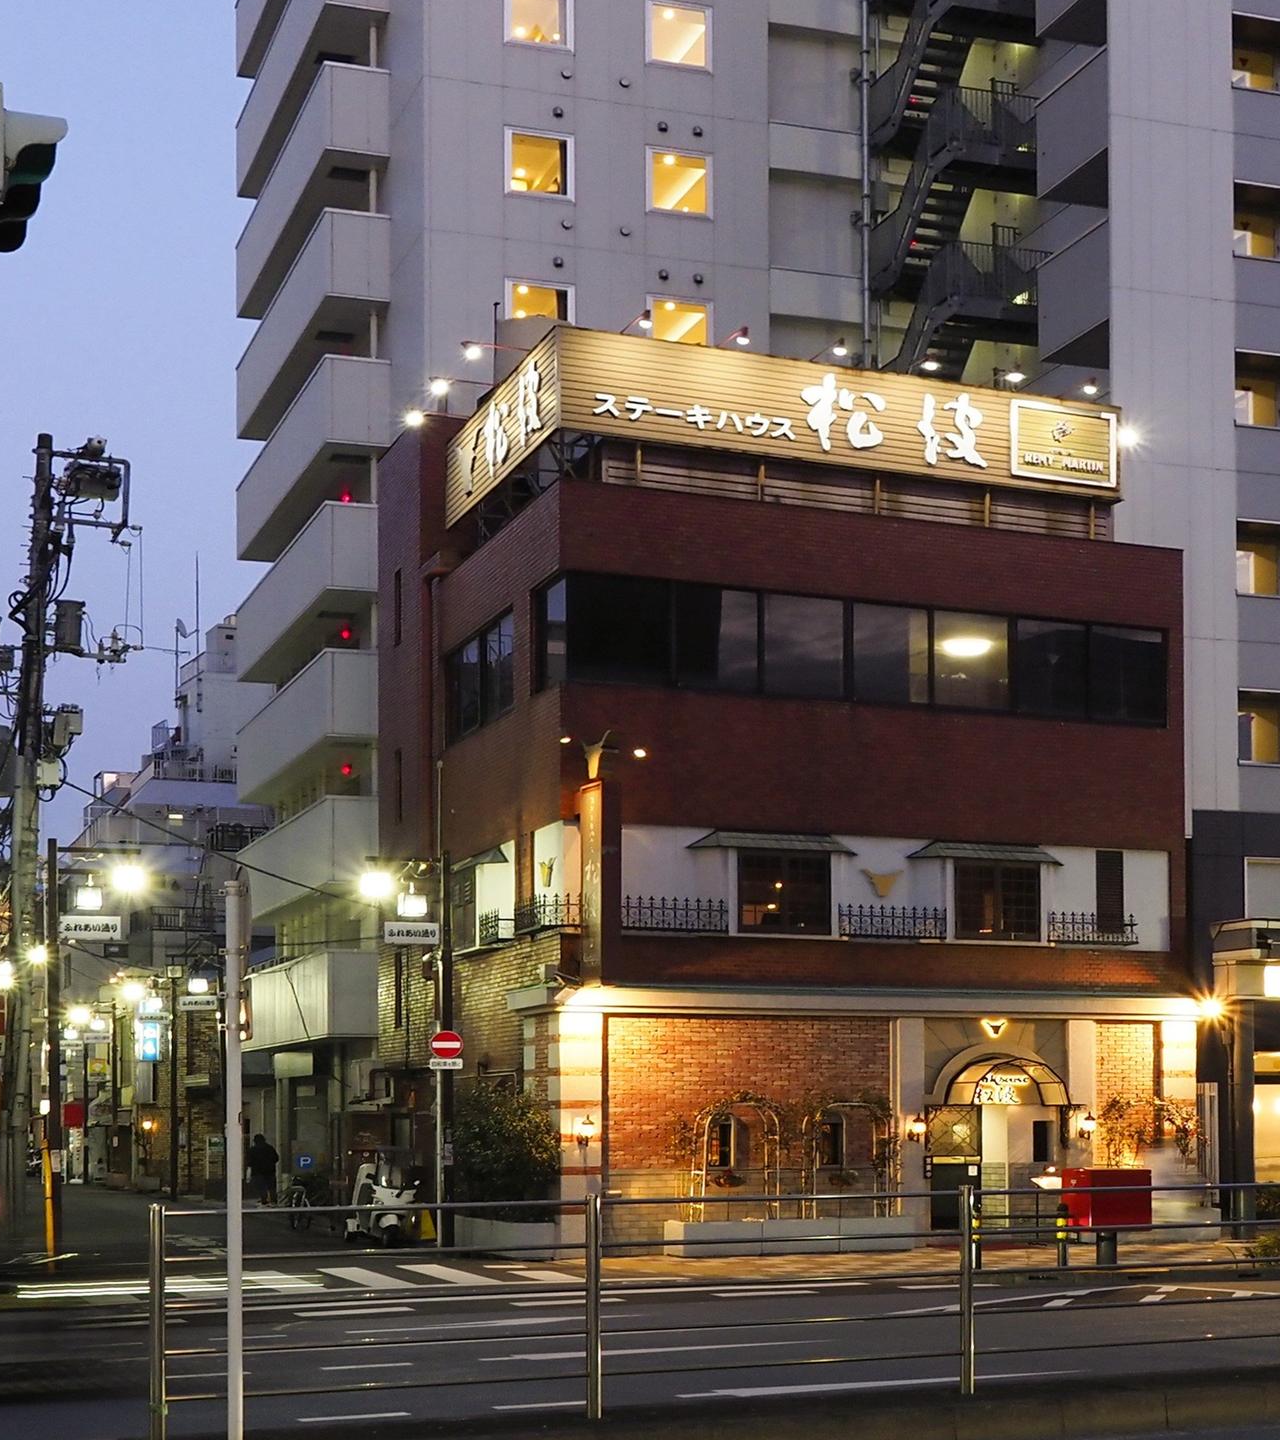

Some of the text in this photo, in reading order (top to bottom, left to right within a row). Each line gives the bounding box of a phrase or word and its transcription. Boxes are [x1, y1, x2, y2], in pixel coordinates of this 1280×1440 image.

[593, 392, 796, 441] ステーキハウス
